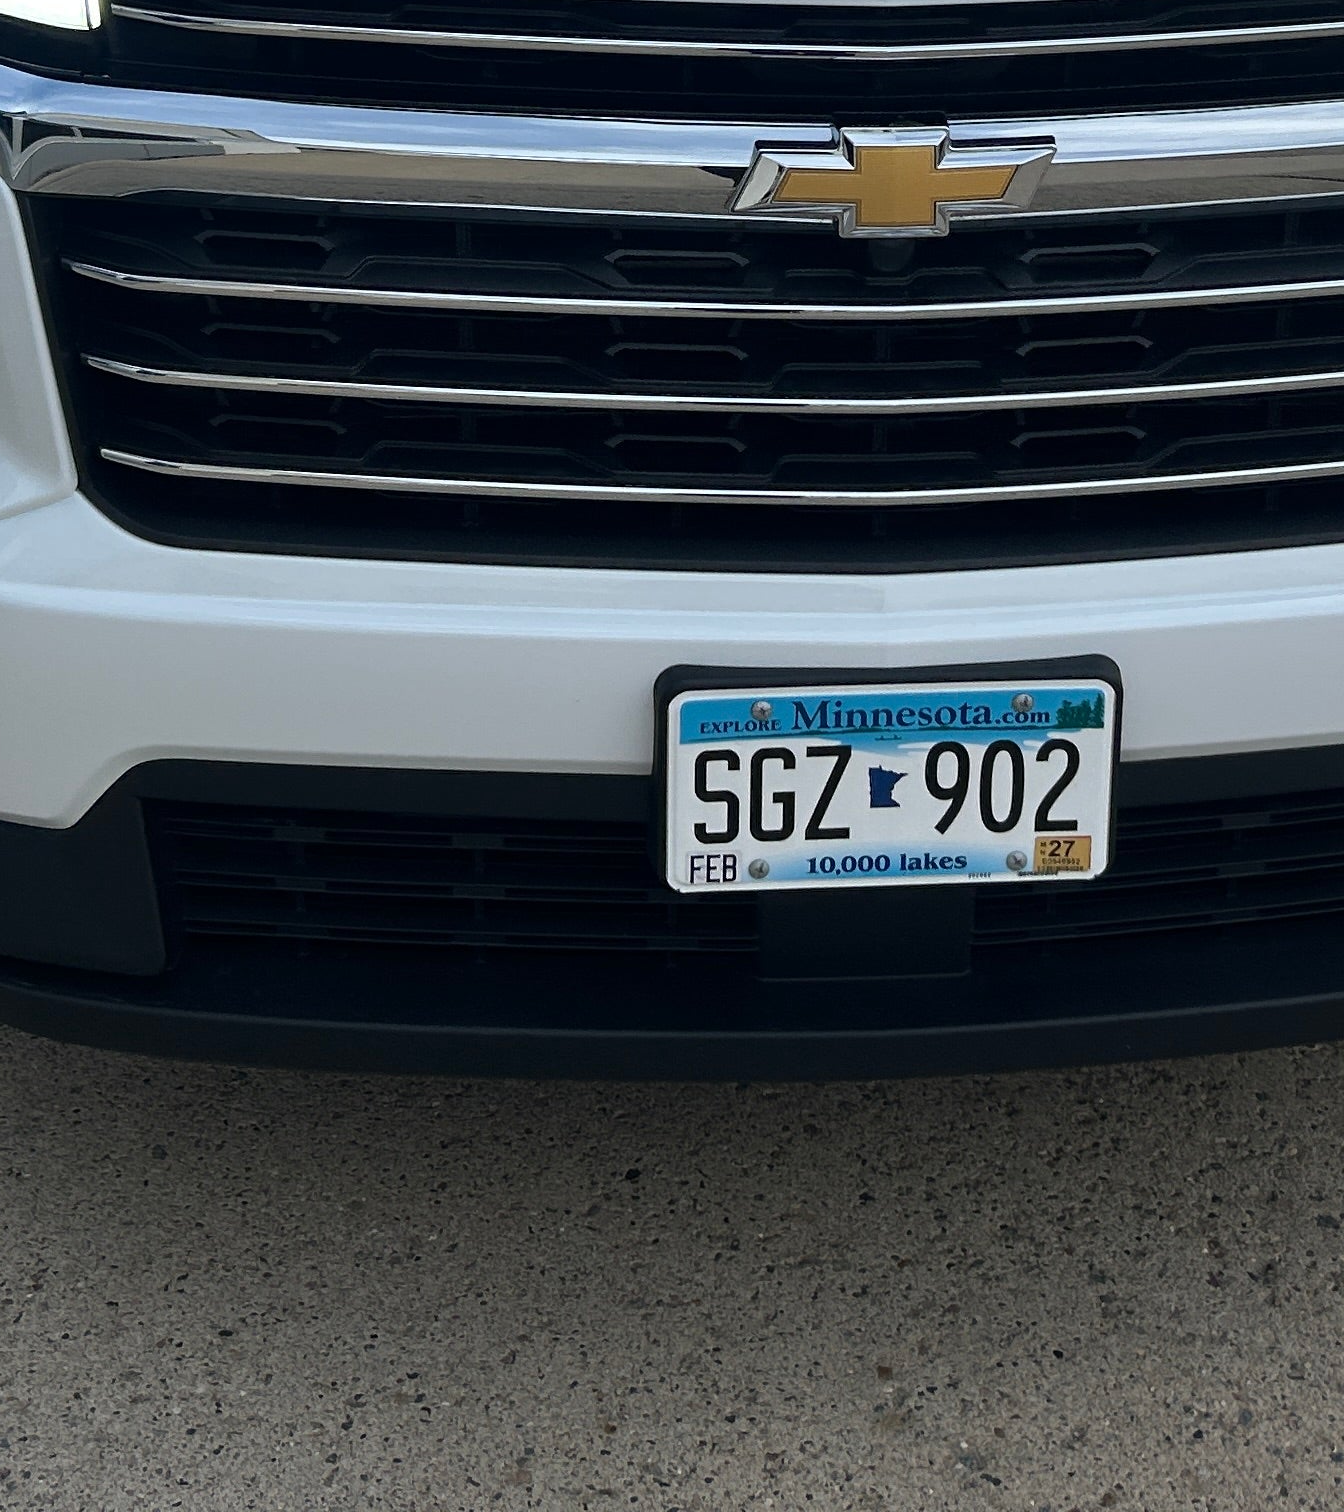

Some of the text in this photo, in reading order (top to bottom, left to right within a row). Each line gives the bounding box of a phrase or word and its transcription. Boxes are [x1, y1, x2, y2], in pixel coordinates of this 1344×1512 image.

[699, 699, 1051, 734] EXPLORE Minnesota.com
[693, 739, 1081, 845] SGZ 902
[1047, 839, 1076, 858] 27
[689, 854, 738, 884] FEB
[806, 852, 968, 876] 10,000 lakes
